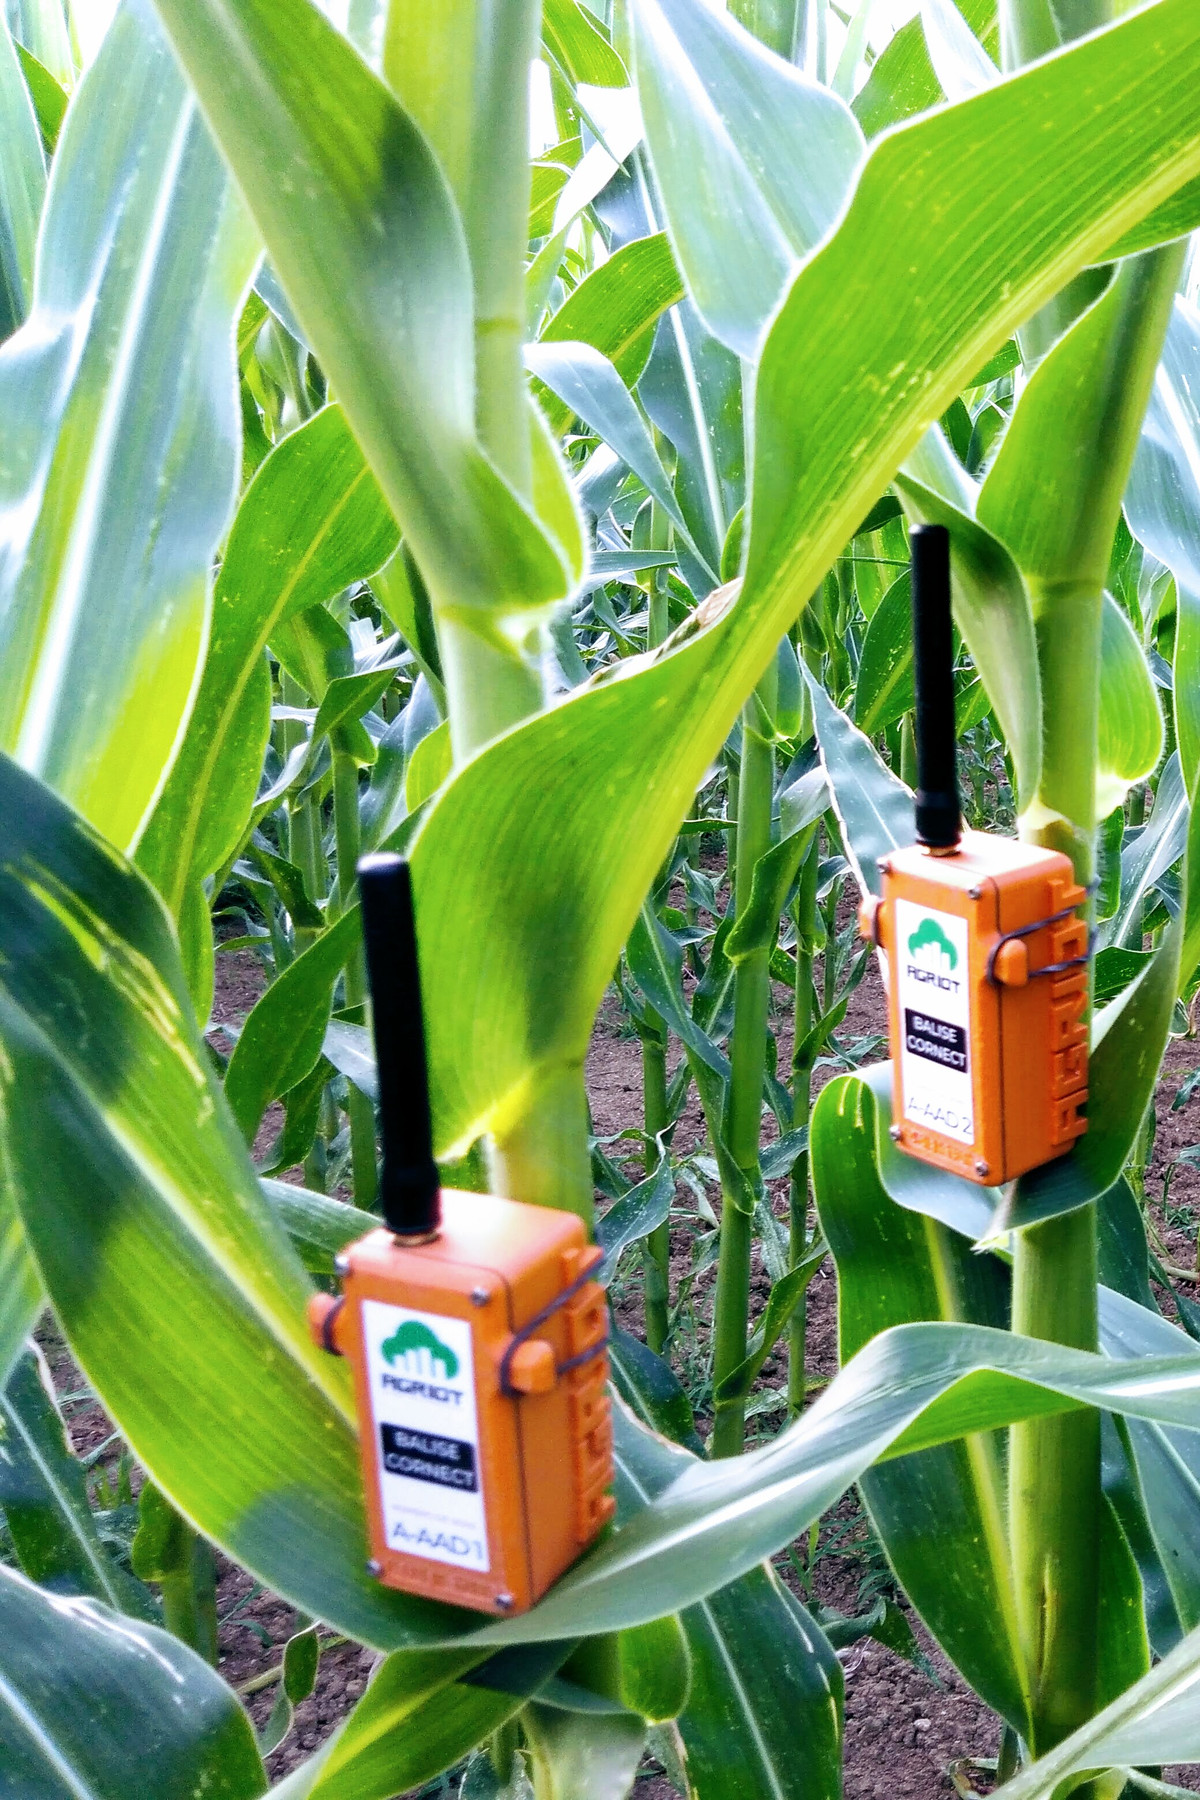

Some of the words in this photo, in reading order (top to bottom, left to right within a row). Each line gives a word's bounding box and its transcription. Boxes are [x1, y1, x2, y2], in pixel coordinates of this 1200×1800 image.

[907, 964, 961, 994] AGRIOT
[912, 1015, 959, 1044] BALISE
[907, 1034, 968, 1068] CORNECT
[381, 1373, 465, 1406] AGRIOT
[394, 1432, 461, 1462] BALISE
[386, 1452, 474, 1488] CORNECT
